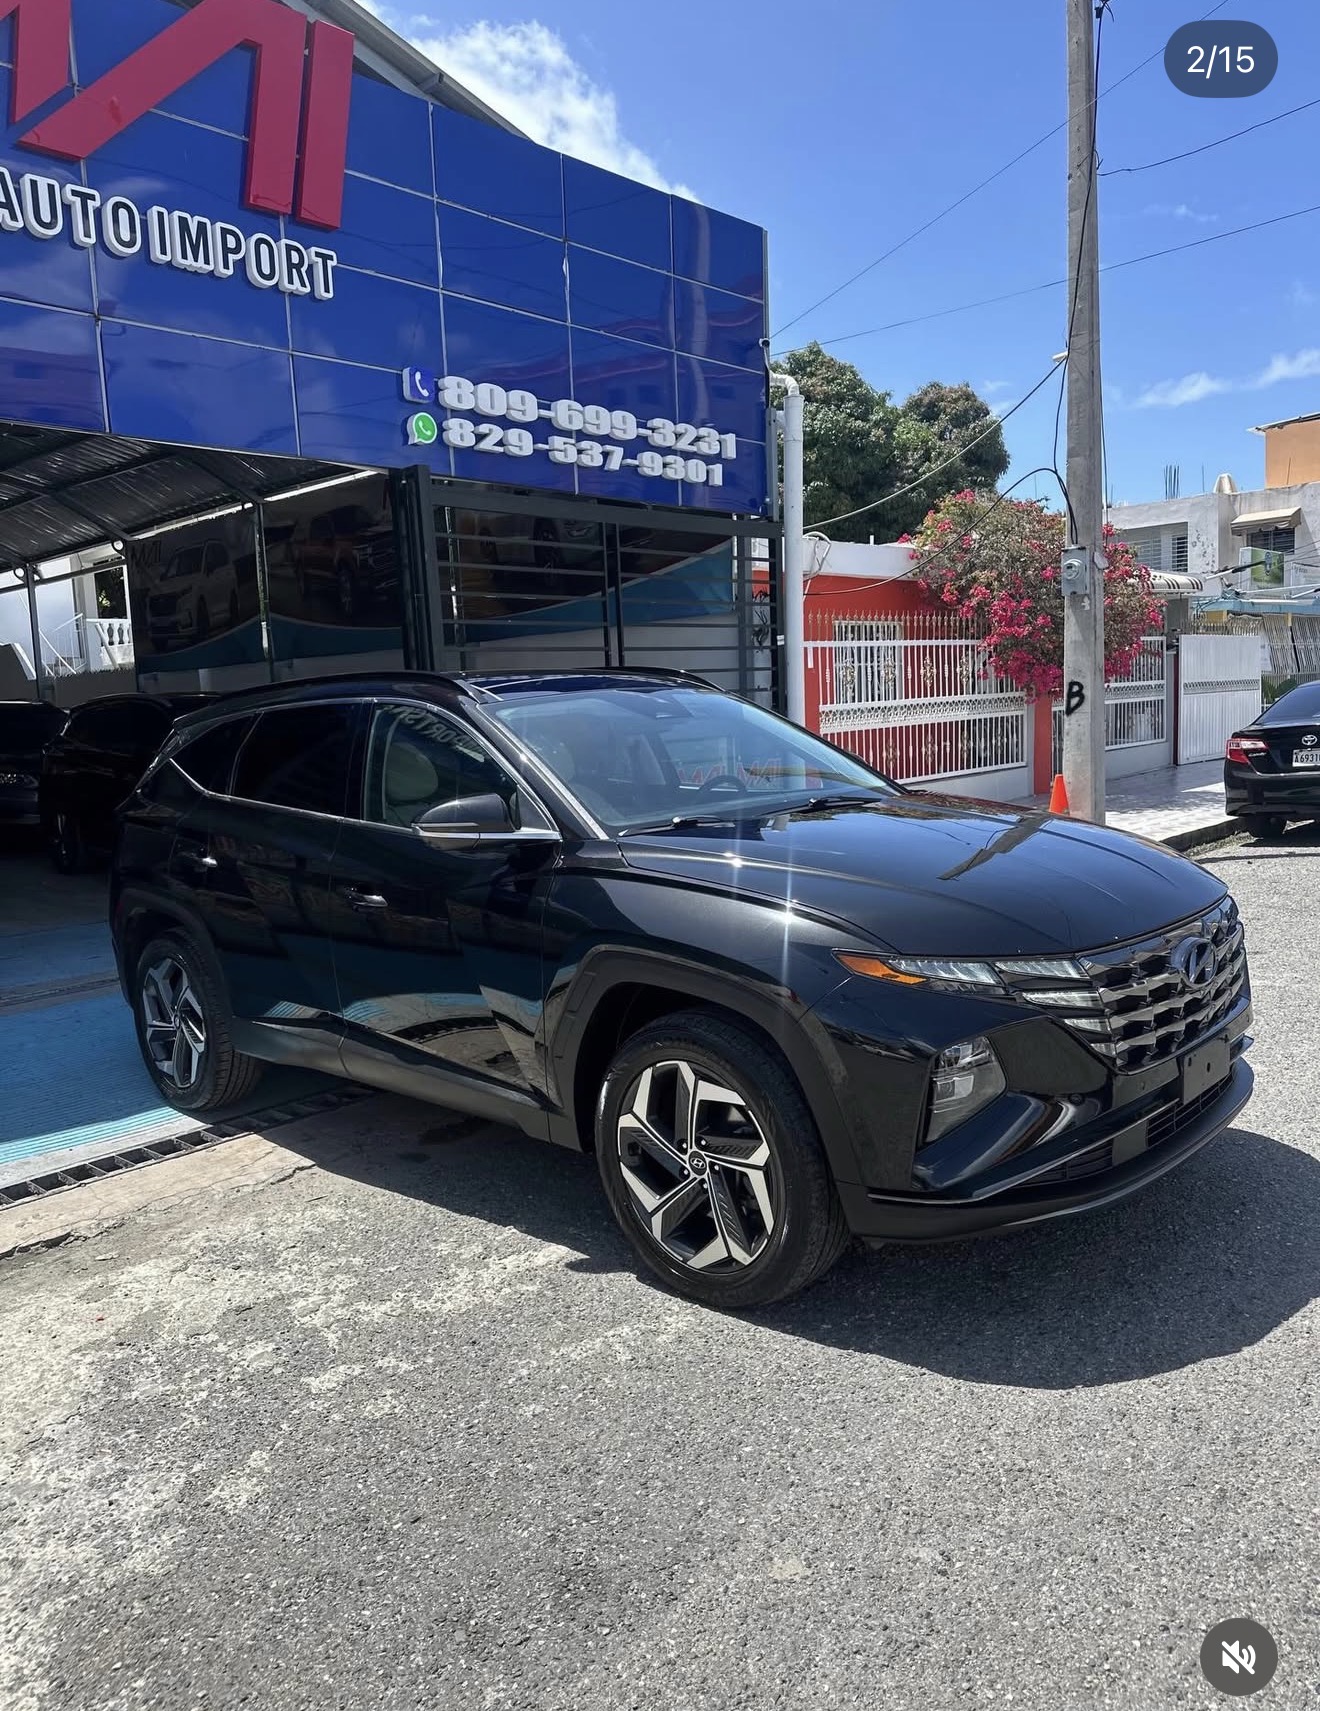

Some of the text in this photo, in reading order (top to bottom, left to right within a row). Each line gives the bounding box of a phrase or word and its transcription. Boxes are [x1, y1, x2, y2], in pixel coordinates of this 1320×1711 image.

[146, 205, 337, 300] IMPORT
[438, 375, 737, 460] 809-699-3231
[442, 417, 724, 487] 829-537-9301
[1065, 680, 1085, 717] B
